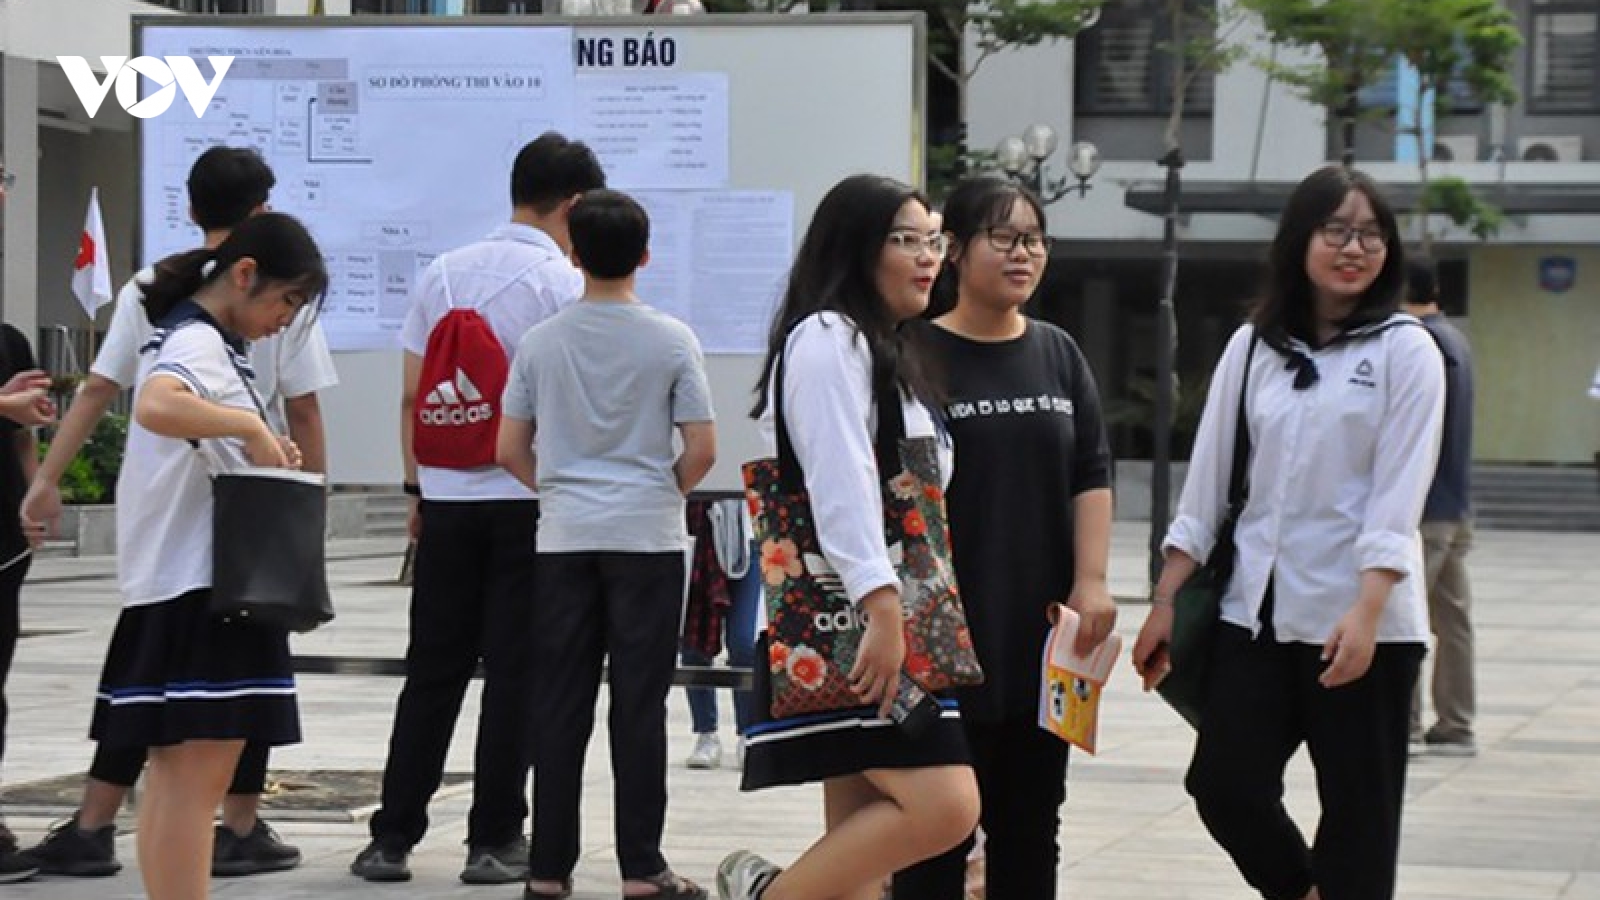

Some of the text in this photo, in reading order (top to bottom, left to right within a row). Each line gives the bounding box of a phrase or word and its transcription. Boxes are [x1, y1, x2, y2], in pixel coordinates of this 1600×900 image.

[577, 31, 677, 68] NG BÁO
[420, 402, 493, 425] adidas
